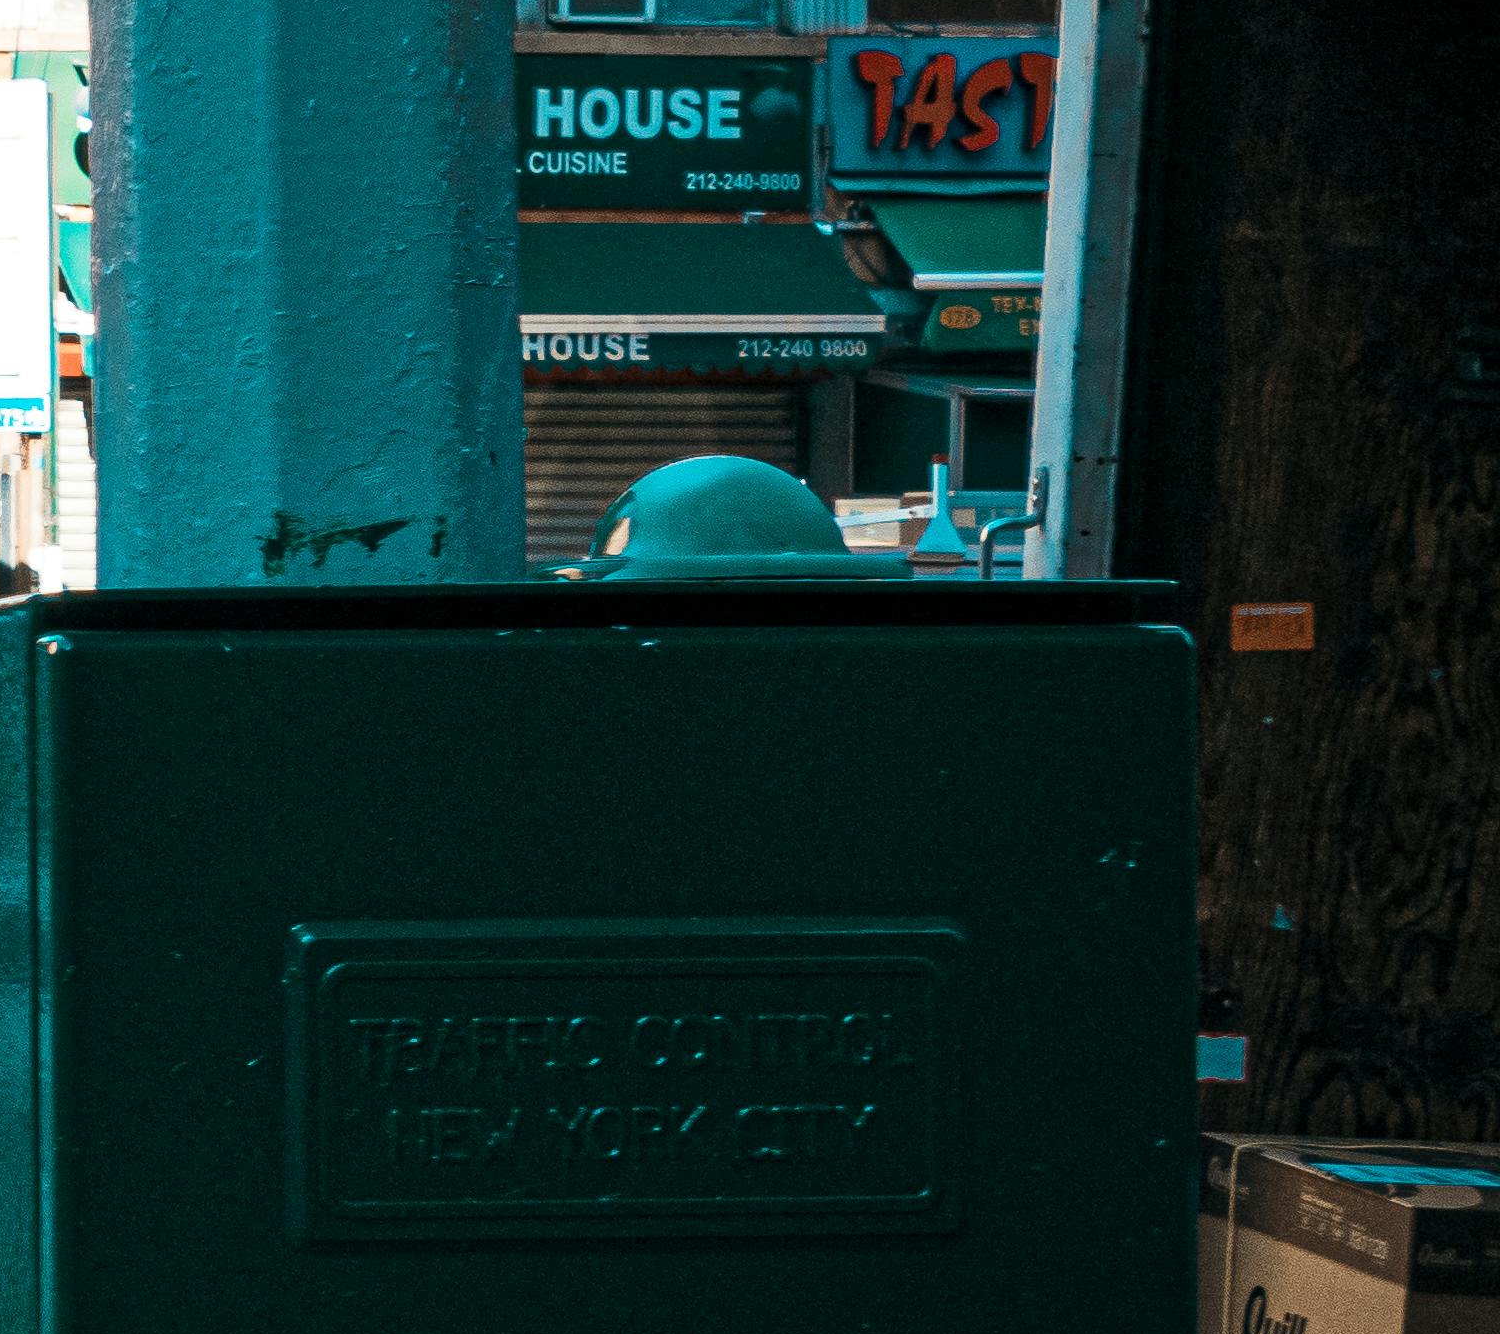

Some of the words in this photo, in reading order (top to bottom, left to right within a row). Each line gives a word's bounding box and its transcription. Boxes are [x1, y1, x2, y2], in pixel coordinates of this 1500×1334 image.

[535, 87, 742, 140] HOUSE
[528, 151, 629, 175] CUISINE
[685, 171, 801, 192] 212-240-9800
[521, 332, 651, 361] HOUSE
[346, 1013, 604, 1075] TRAFFIC
[546, 1103, 710, 1161] YORK
[734, 1101, 879, 1161] CITY
